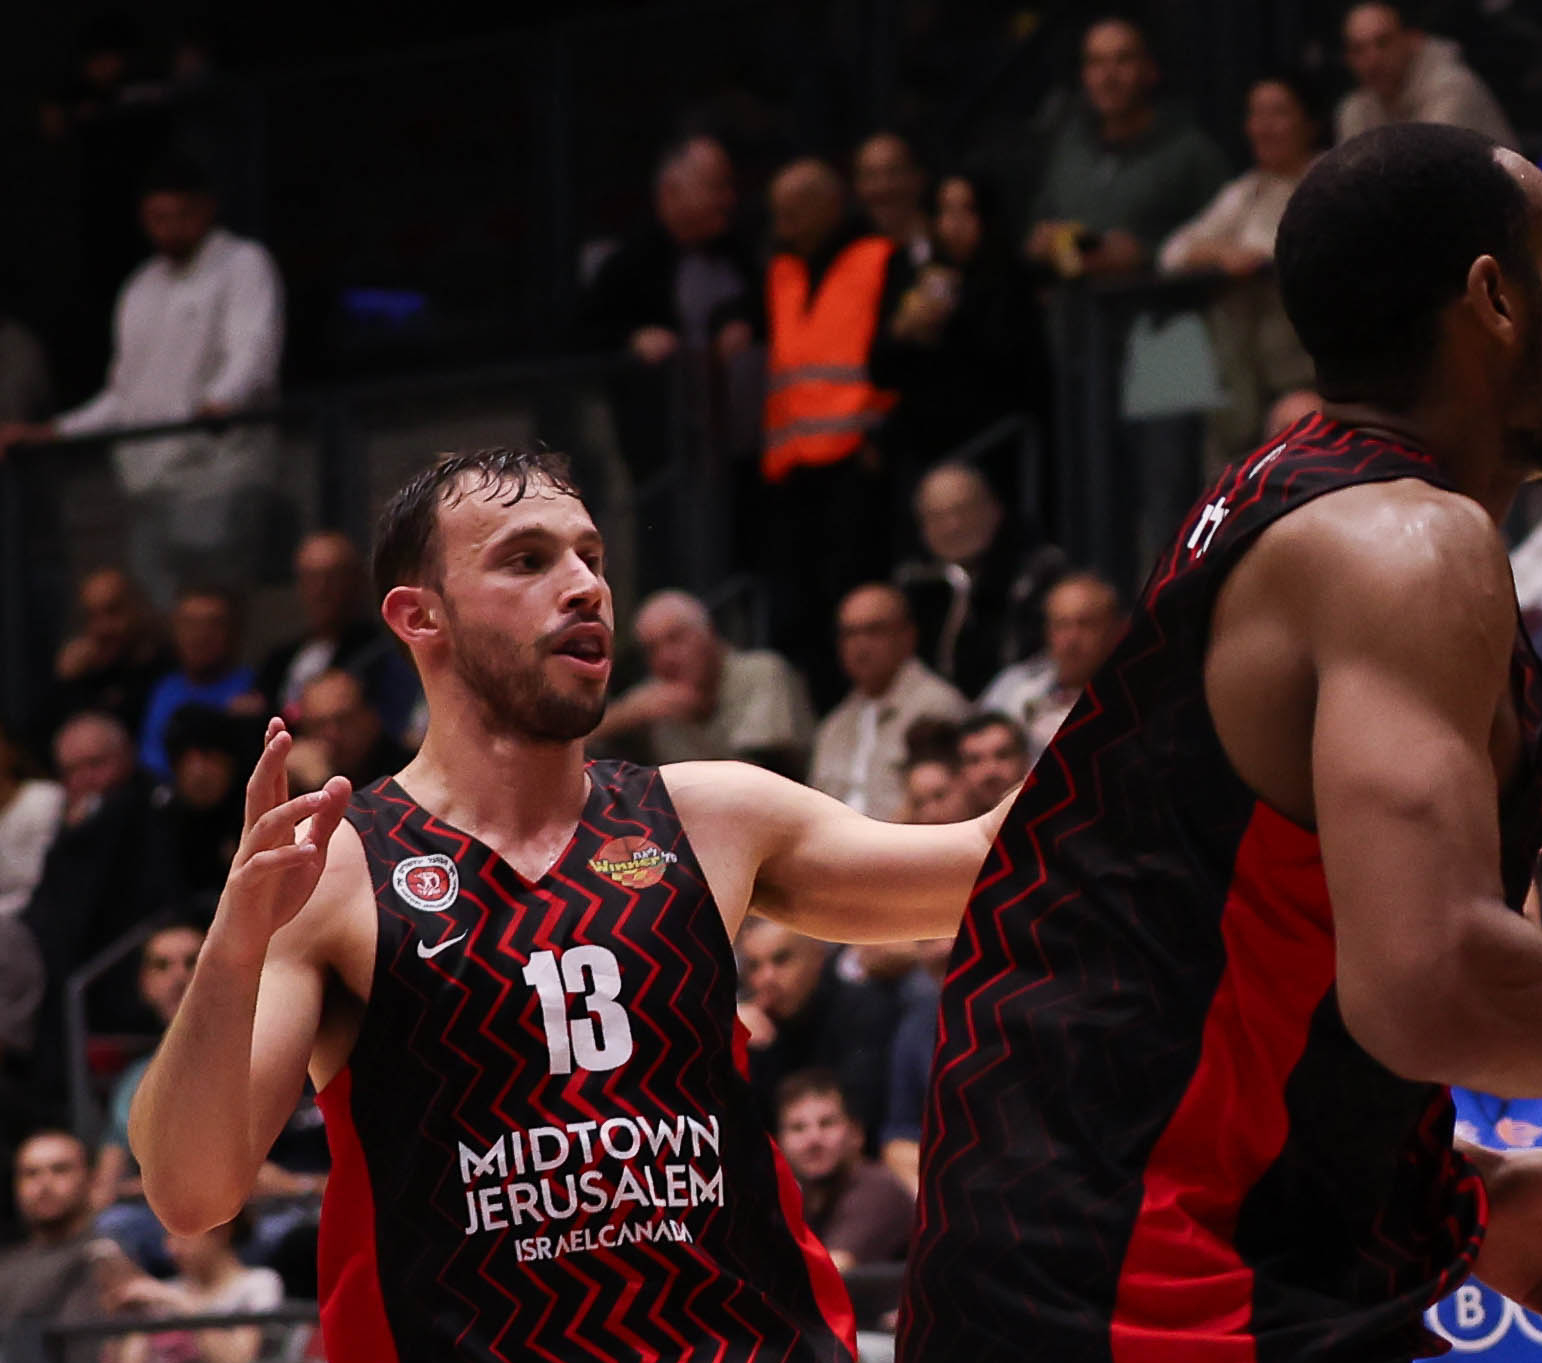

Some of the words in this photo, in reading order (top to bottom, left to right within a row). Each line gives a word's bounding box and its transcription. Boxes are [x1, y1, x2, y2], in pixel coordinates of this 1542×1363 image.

[521, 944, 633, 1076] 13
[458, 1115, 720, 1183] MIDTOWN
[465, 1164, 725, 1235] JERUSALEM
